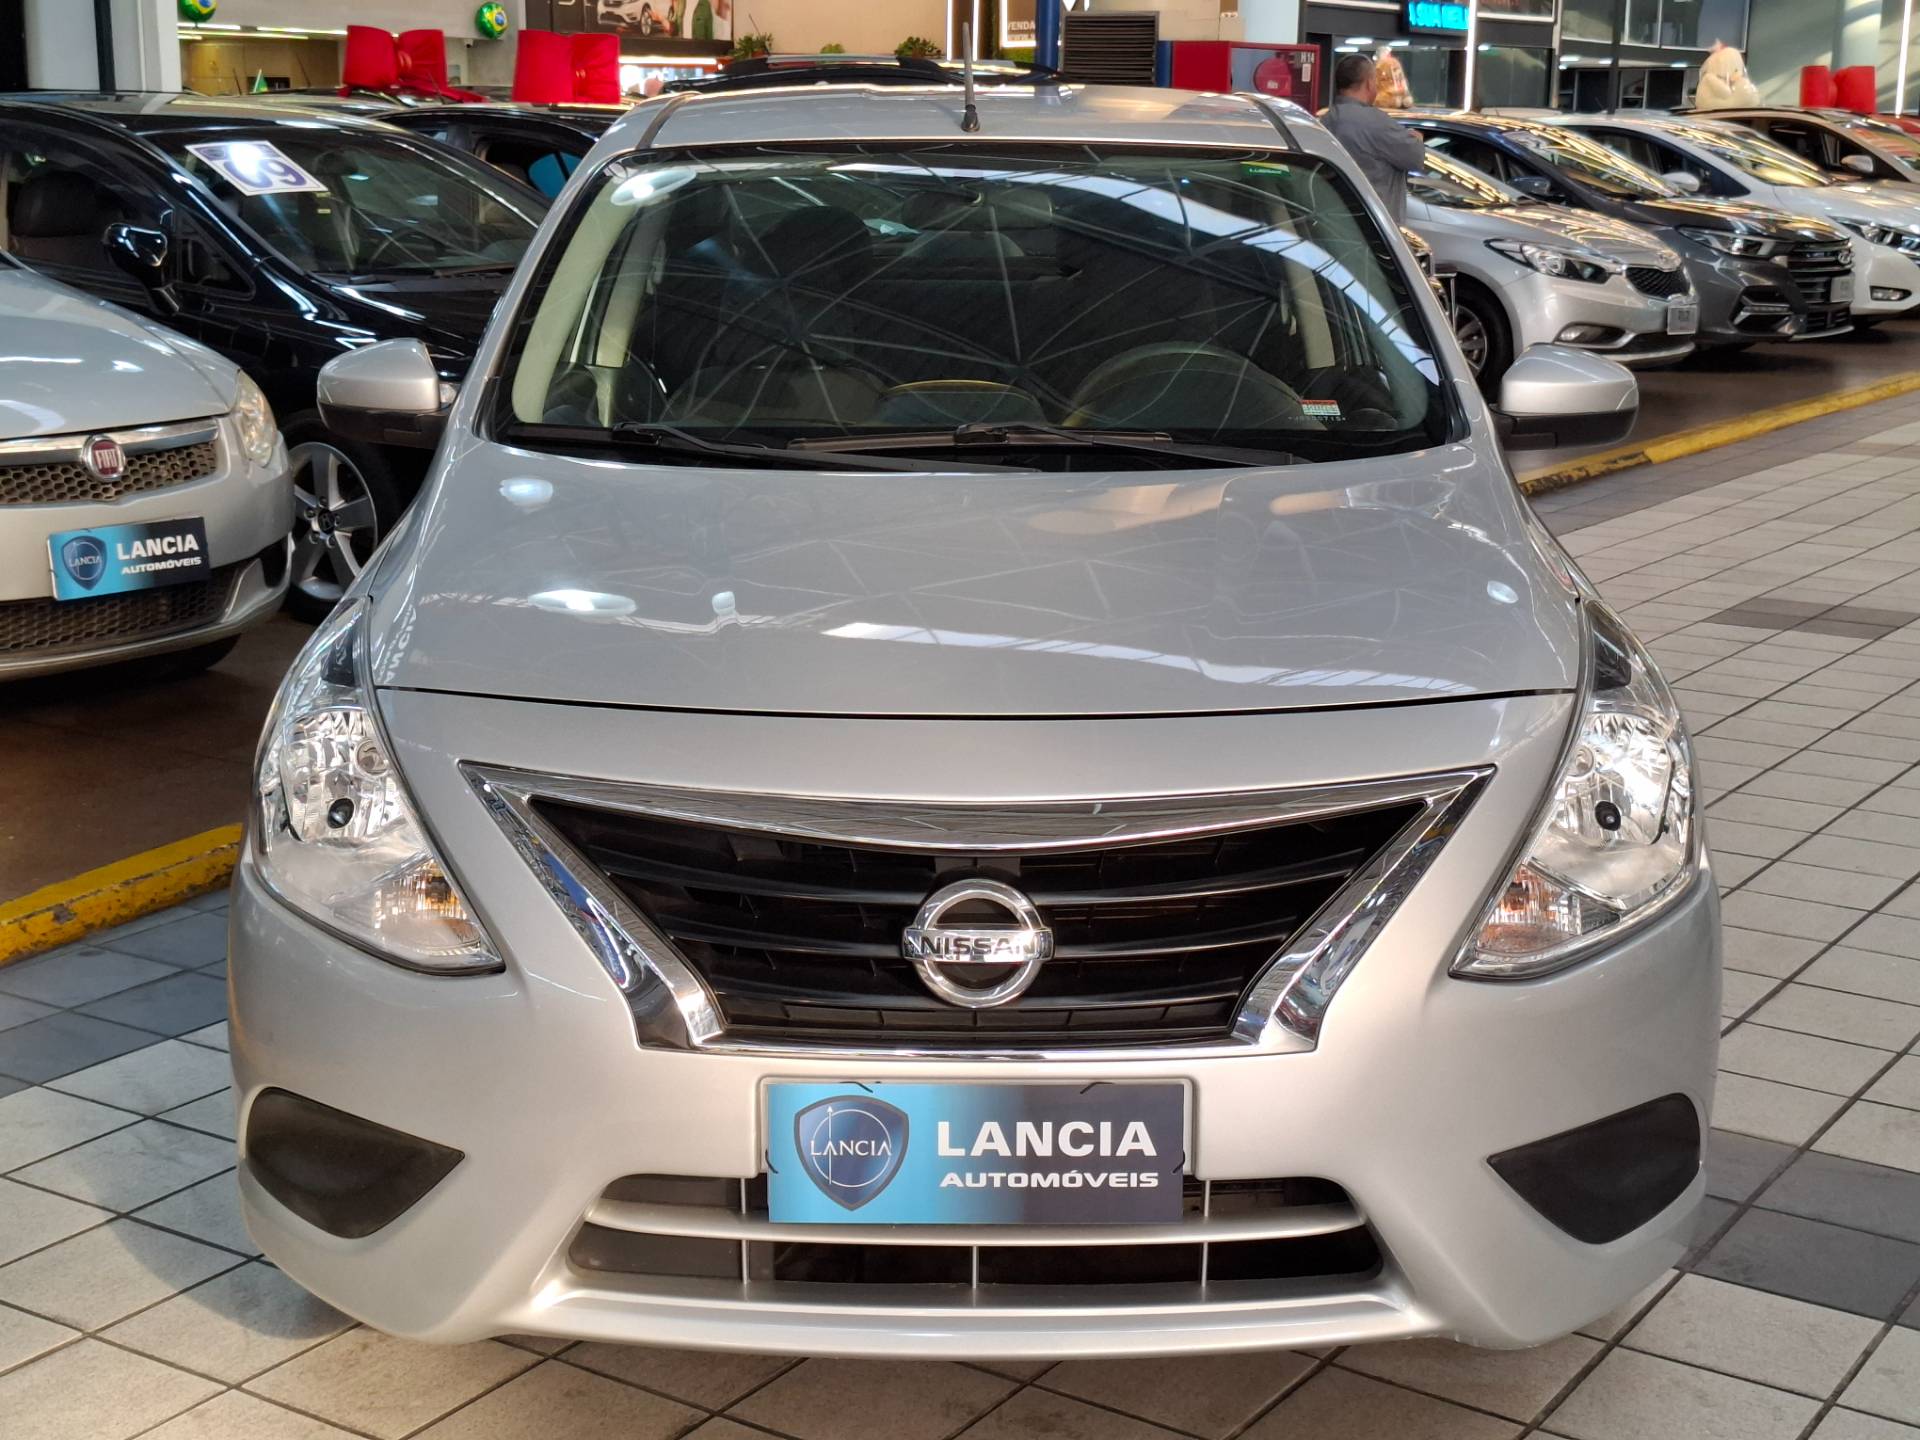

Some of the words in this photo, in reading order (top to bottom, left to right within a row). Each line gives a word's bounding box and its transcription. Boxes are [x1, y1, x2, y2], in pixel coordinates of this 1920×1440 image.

[95, 448, 121, 469] FIAT
[116, 533, 199, 560] LANCIA
[121, 556, 202, 574] AUTOMÓVEIS
[920, 936, 1036, 956] NISSAN
[810, 1139, 892, 1156] LANCIA
[937, 1121, 1158, 1157] LANCIA
[939, 1169, 1159, 1188] AUTOMÓVEIS
